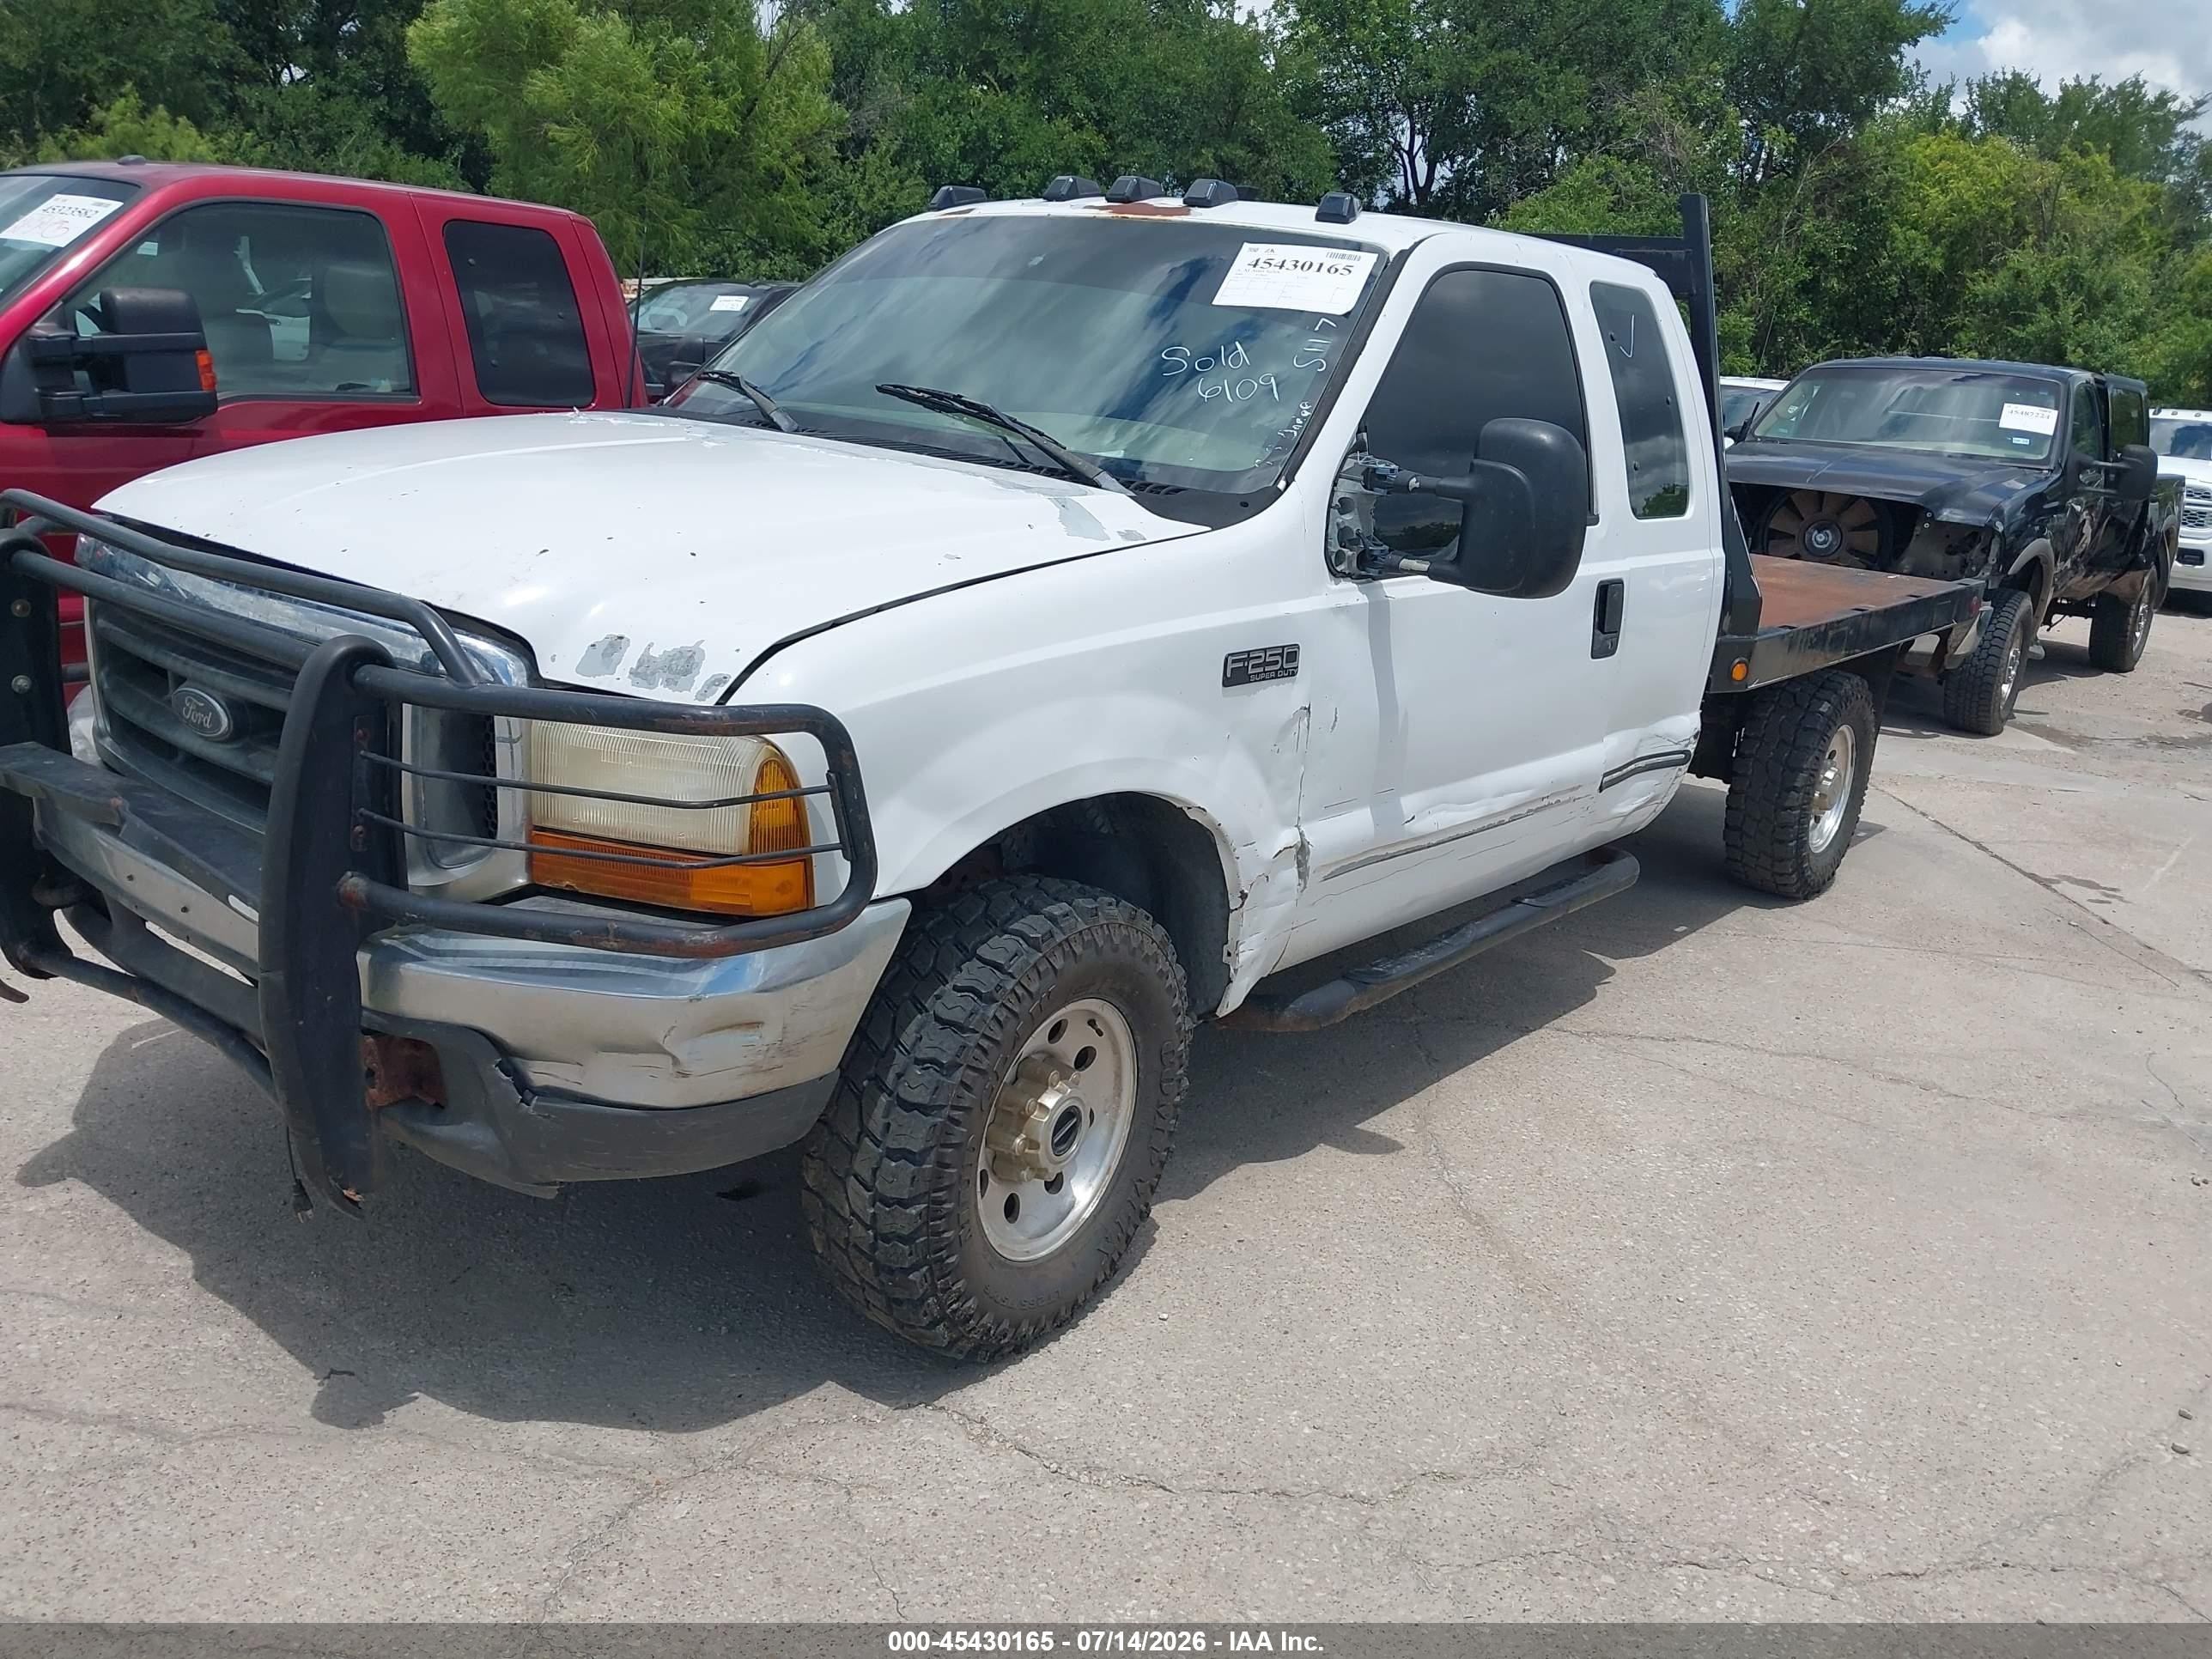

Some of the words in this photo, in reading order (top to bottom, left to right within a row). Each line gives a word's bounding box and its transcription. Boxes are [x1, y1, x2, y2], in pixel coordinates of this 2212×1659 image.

[1247, 257, 1355, 276] 45430165
[1161, 341, 1251, 376] Sold
[1197, 373, 1279, 404] 6109
[1226, 646, 1299, 678] F-250
[1249, 672, 1276, 682] SUPER
[1278, 668, 1298, 678] DUTY
[182, 696, 214, 729] Ford
